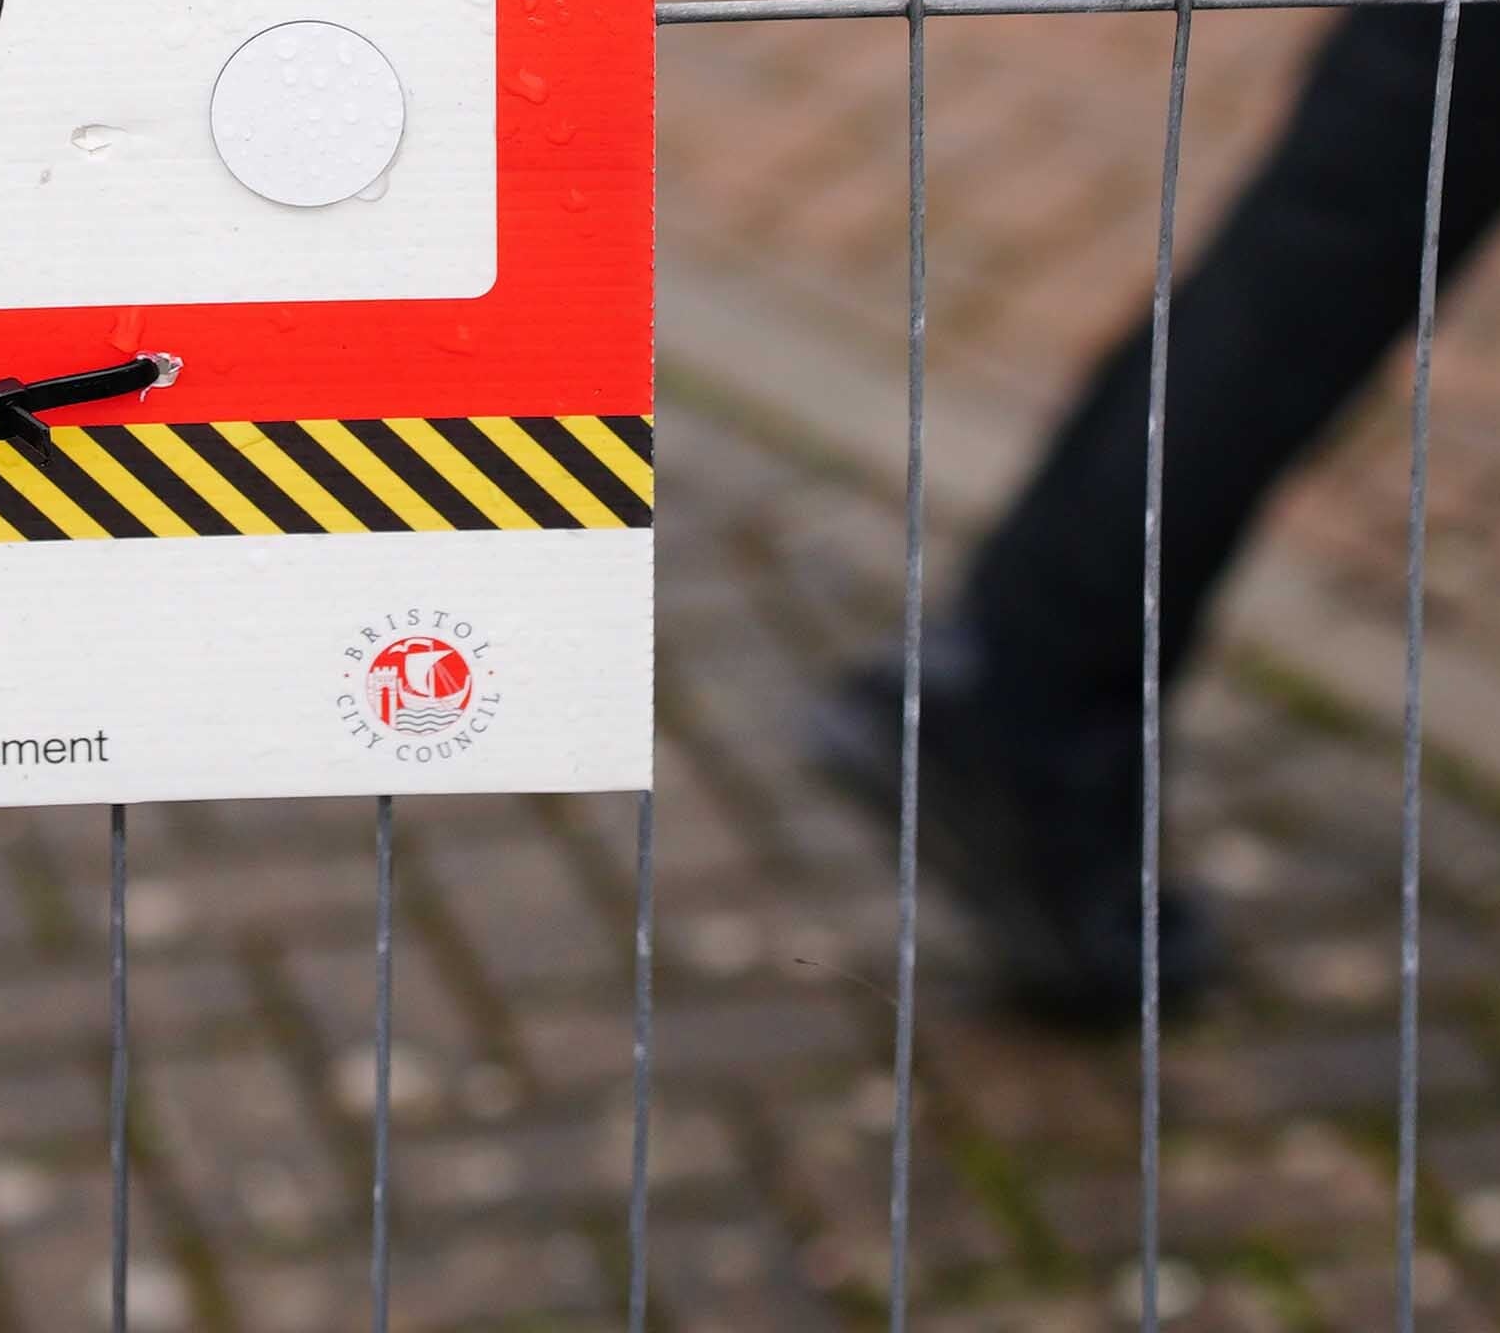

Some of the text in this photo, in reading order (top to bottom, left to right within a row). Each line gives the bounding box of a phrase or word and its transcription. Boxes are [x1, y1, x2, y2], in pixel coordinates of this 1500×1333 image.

[345, 608, 491, 662] BRISTOL
[336, 692, 501, 763] CITY COUNCIL
